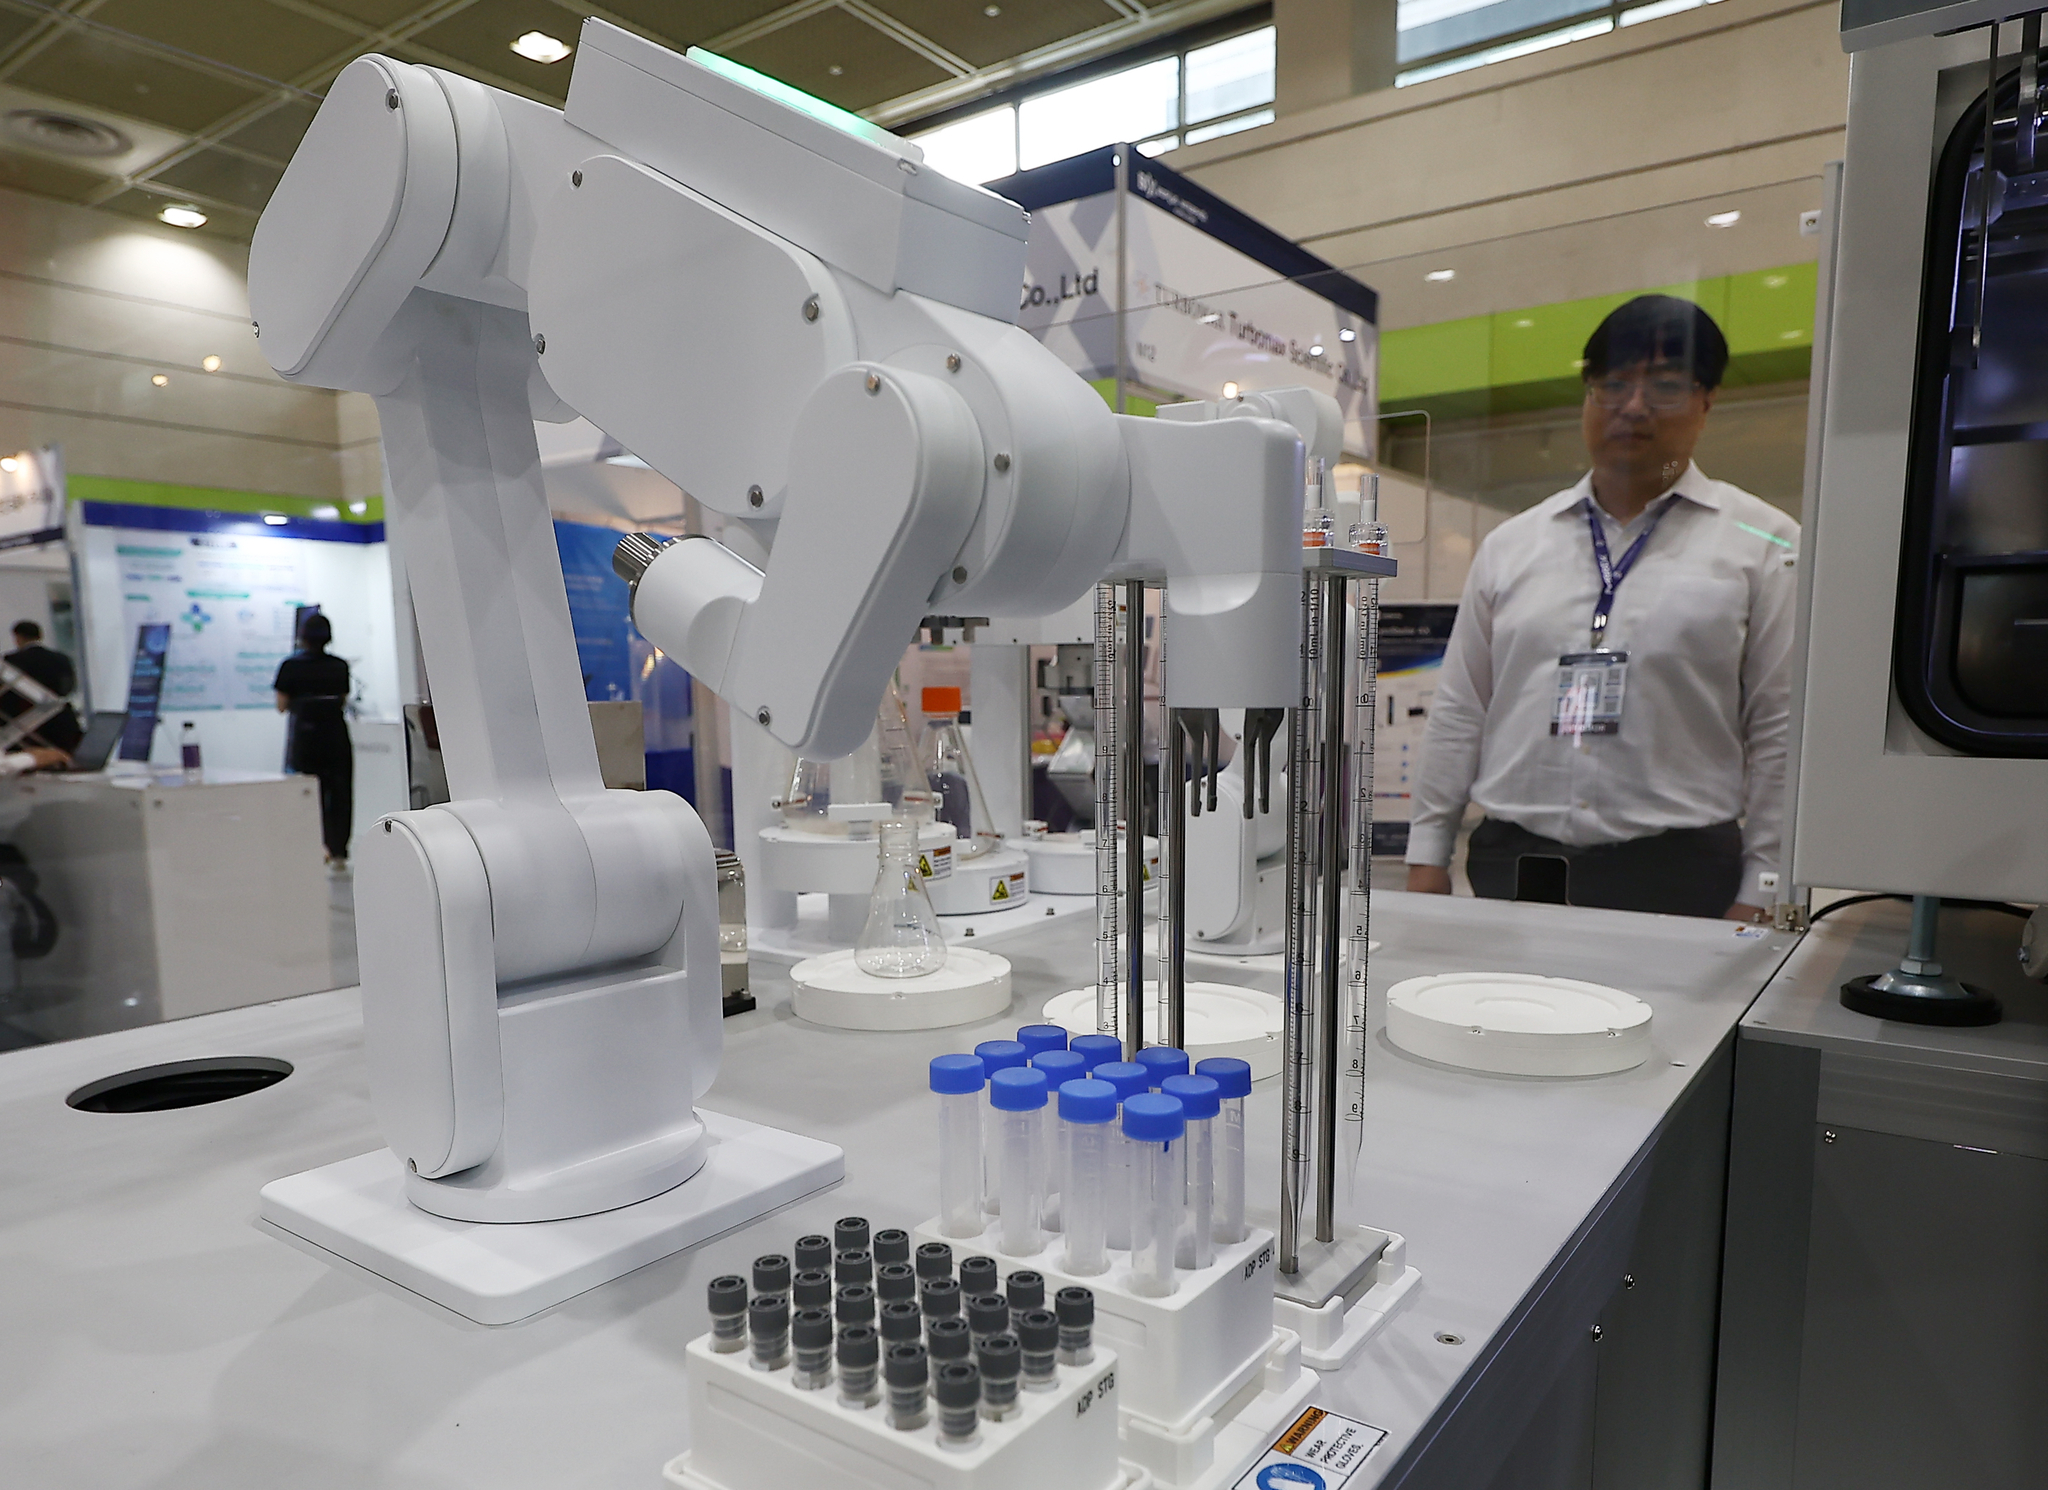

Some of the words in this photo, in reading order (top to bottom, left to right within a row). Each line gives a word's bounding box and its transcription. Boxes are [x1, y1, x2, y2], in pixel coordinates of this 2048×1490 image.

[1102, 745, 1108, 754] 9
[1102, 793, 1107, 802] 8
[1300, 800, 1308, 812] 2
[1102, 839, 1108, 848] 7
[1102, 885, 1108, 893] 6
[1102, 931, 1109, 940] 5
[1103, 976, 1109, 985] 4
[1103, 1022, 1109, 1030] 3
[1244, 1260, 1256, 1281] ADP
[1258, 1248, 1270, 1269] STG
[1076, 1391, 1093, 1417] ADP
[1098, 1372, 1115, 1399] STG
[1286, 1409, 1326, 1446] WARNING
[1304, 1440, 1325, 1459] WEAR
[1320, 1427, 1357, 1464] PROTECTIVE
